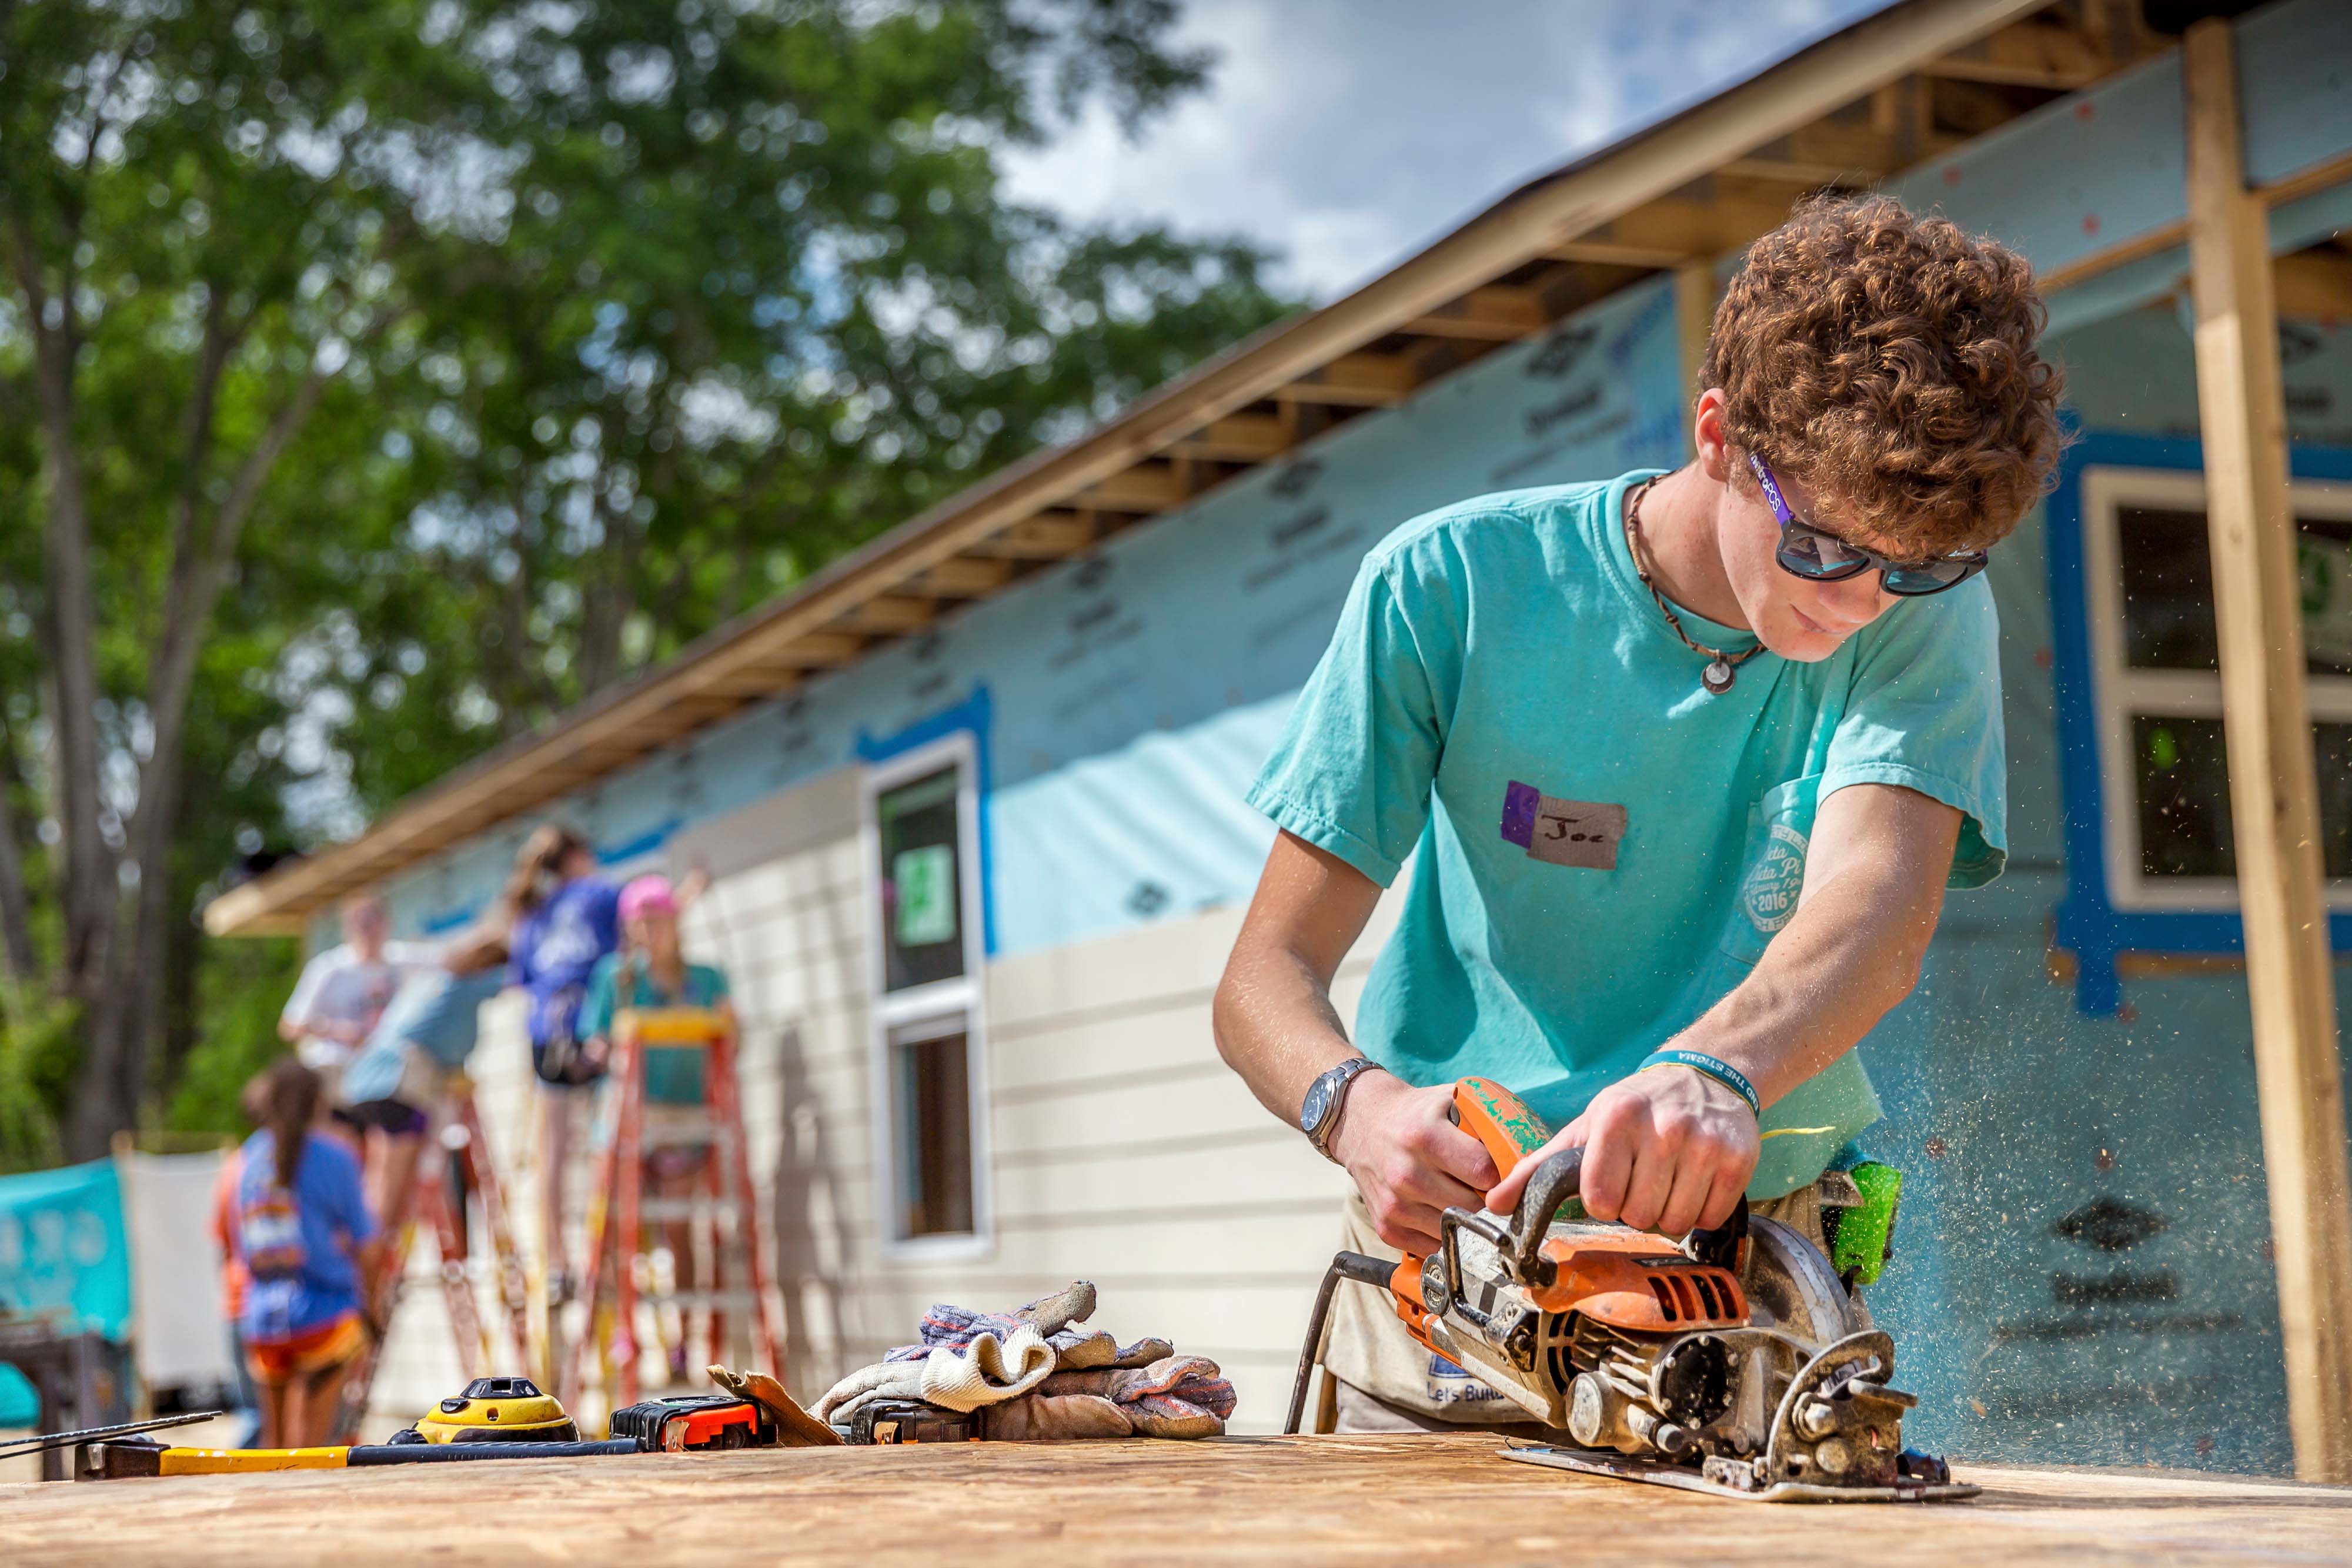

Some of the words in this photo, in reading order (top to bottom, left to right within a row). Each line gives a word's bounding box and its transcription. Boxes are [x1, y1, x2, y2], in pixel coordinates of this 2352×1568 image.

[1541, 814, 1604, 843] Joe
[1779, 857, 1801, 878] Pi
[1758, 891, 1788, 912] 2016
[1679, 1051, 1725, 1072] STIGMA
[1724, 1067, 1745, 1089] THE
[1746, 1086, 1759, 1111] END
